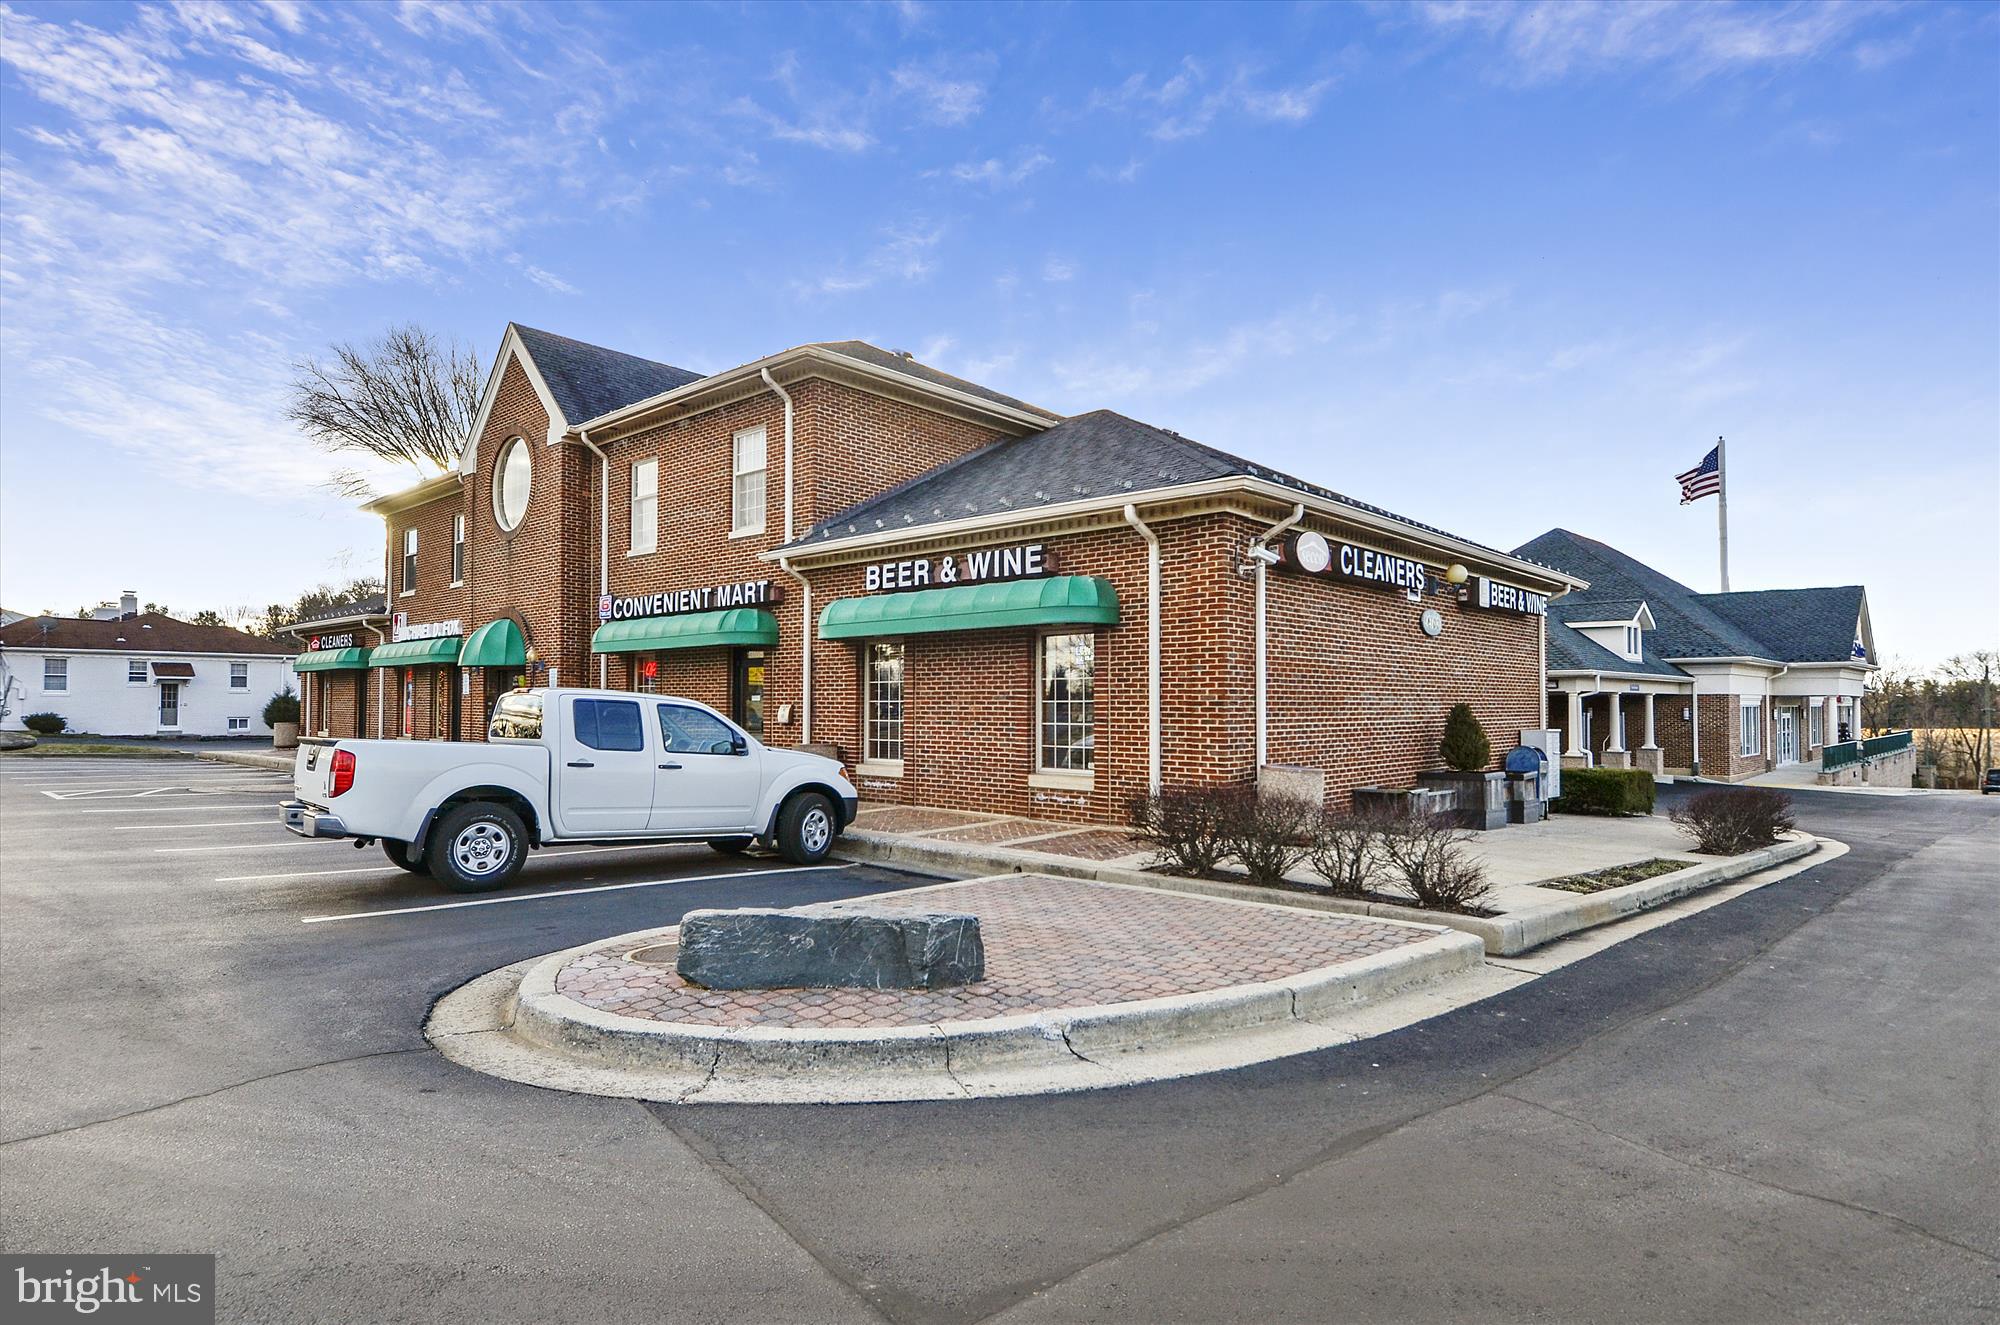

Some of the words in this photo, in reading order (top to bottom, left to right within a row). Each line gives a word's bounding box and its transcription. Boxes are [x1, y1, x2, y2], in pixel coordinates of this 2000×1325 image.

[866, 559, 930, 591] BEER
[940, 556, 957, 583] &
[967, 544, 1043, 580] WINE
[1340, 545, 1425, 590] CLEANERS
[613, 587, 712, 619] CONVENIENT
[717, 580, 769, 607] MART
[1491, 583, 1517, 609] BEER
[1518, 591, 1526, 612] &
[1526, 592, 1548, 616] WINE
[320, 633, 353, 650] CLEANERS
[442, 619, 461, 635] FOX
